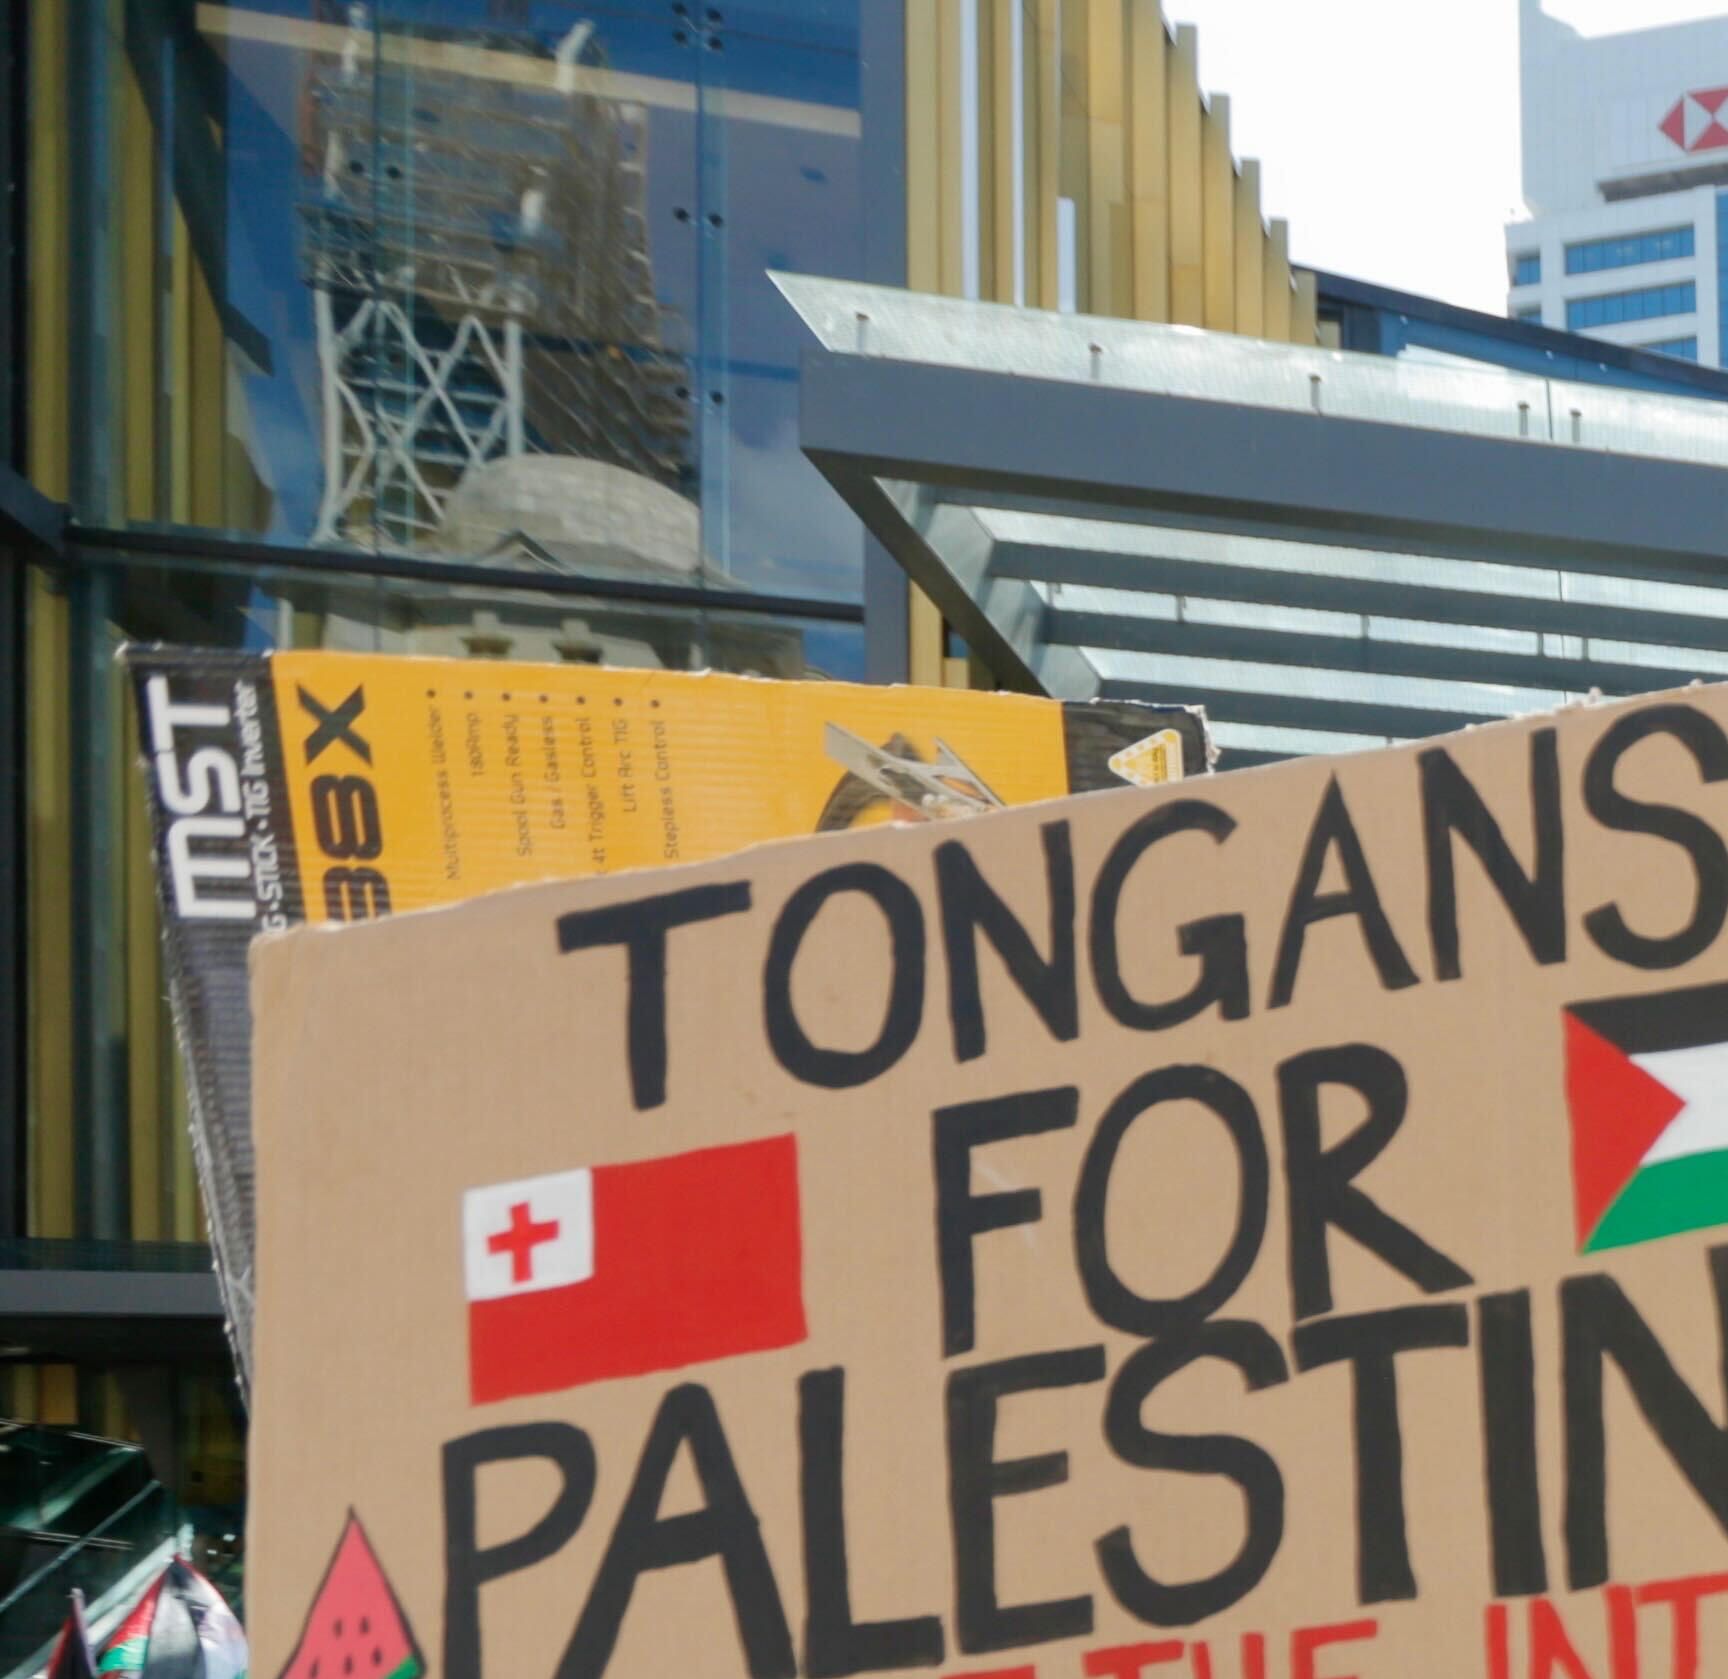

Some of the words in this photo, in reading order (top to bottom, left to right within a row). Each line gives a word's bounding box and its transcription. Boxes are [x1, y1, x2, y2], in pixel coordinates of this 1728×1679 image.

[233, 680, 268, 781] Inverter
[576, 716, 598, 779] Control
[650, 720, 673, 782] Control
[146, 672, 258, 920] MST
[933, 1044, 1475, 1358] FOR
